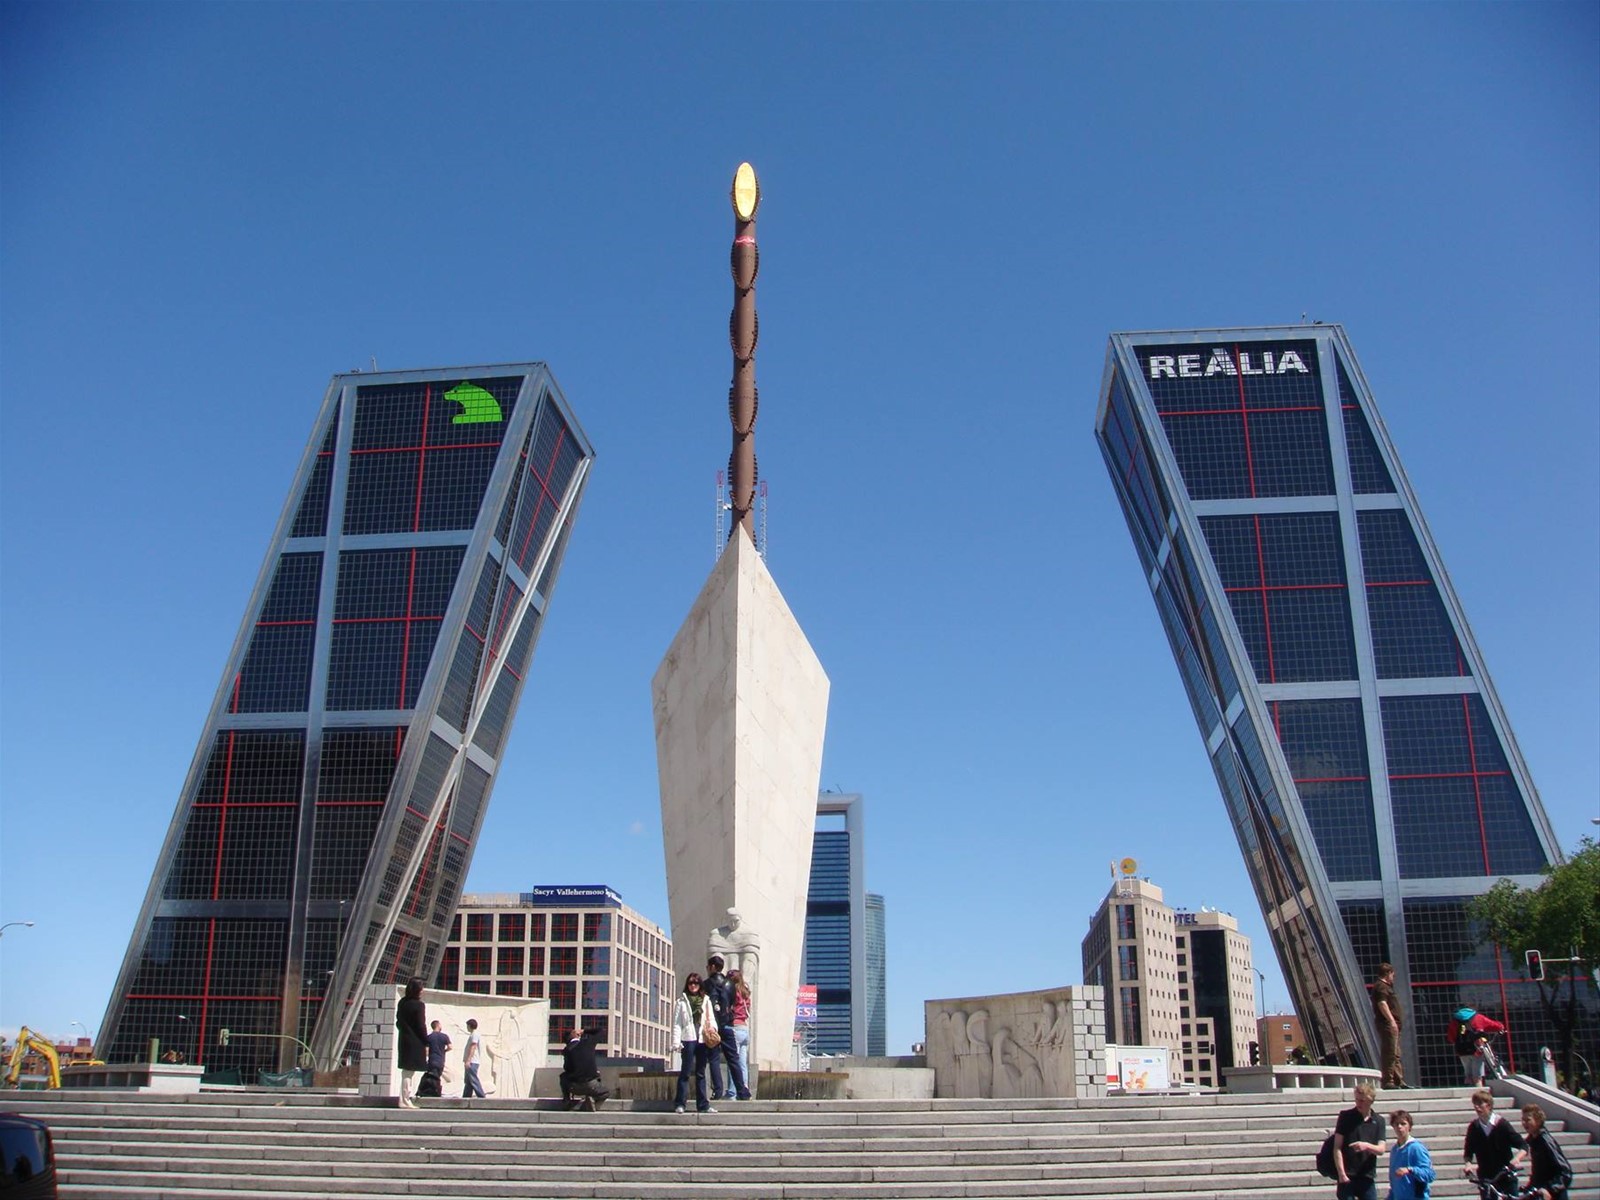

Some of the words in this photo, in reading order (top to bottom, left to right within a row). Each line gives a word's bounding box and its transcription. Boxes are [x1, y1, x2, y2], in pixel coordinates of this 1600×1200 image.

[1150, 348, 1309, 379] REALIA
[533, 888, 554, 896] Sacyr
[556, 888, 604, 896] Vallehermoso
